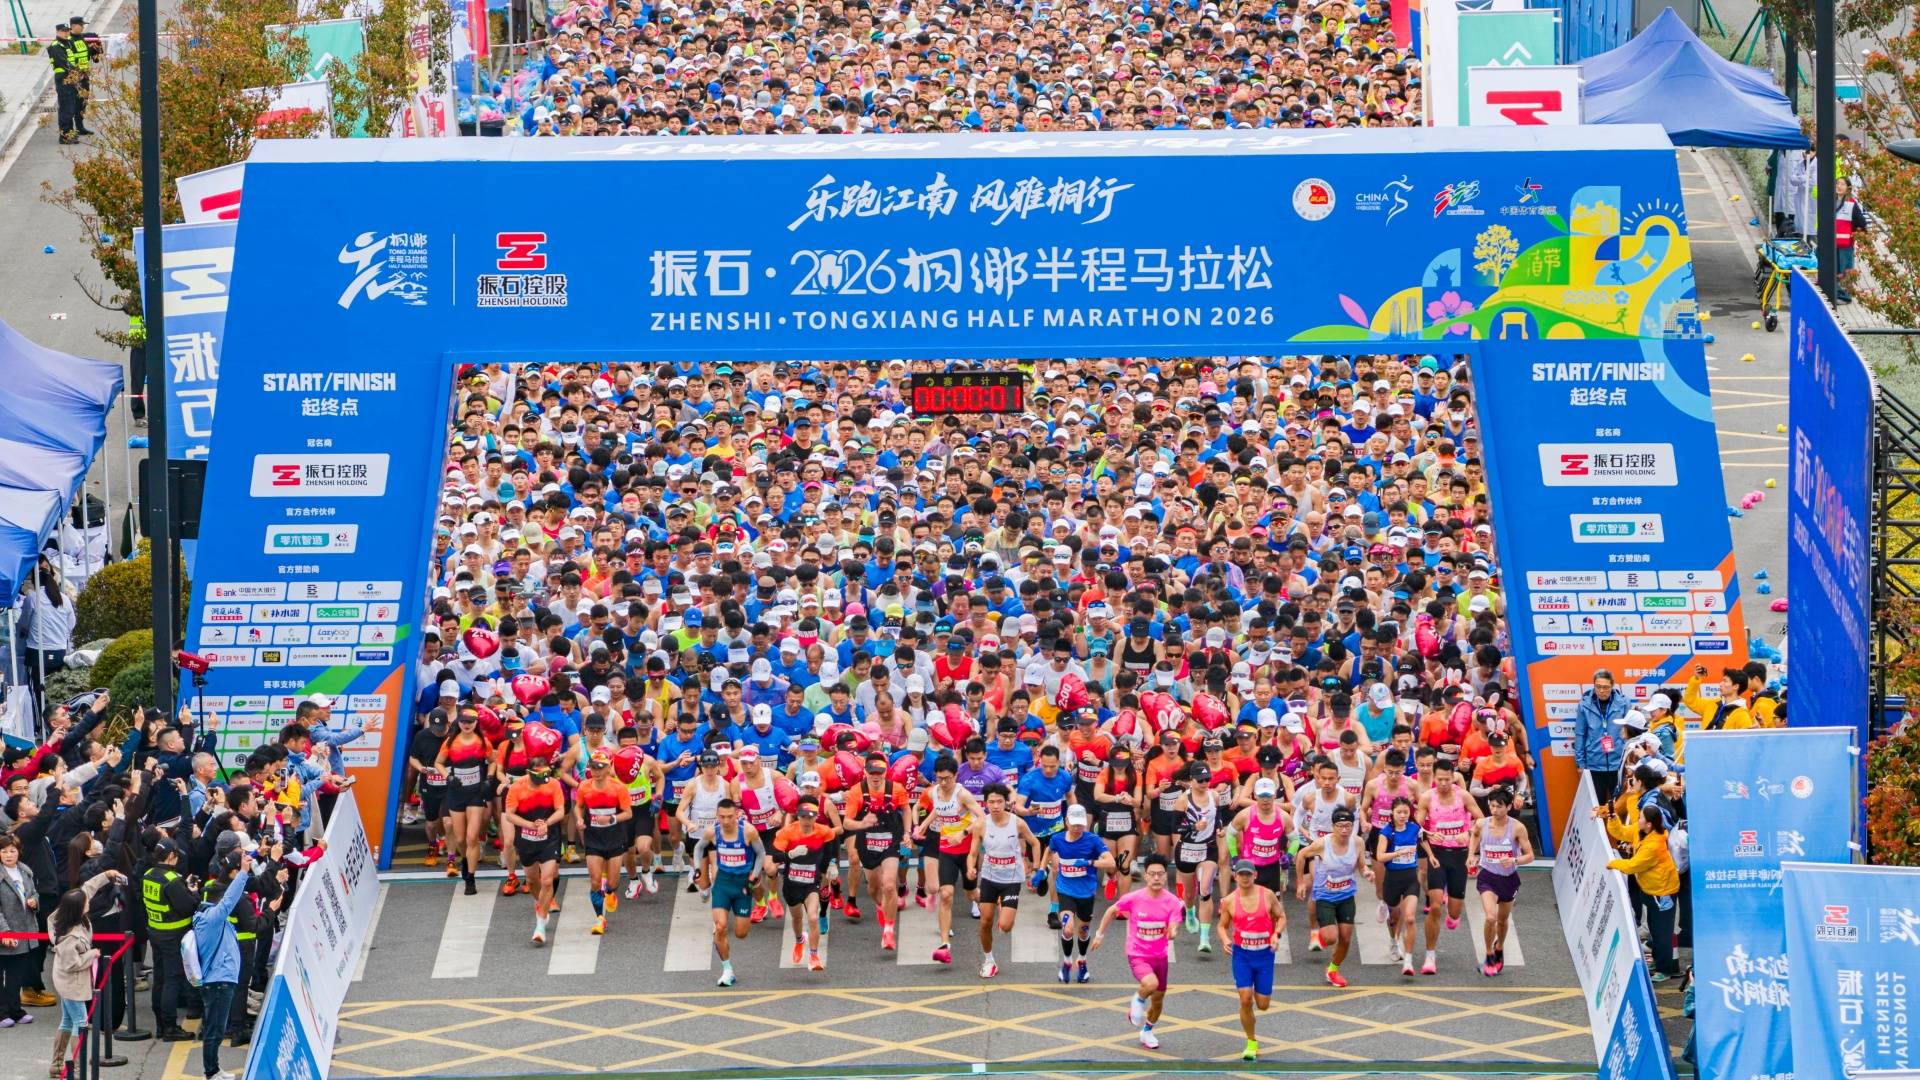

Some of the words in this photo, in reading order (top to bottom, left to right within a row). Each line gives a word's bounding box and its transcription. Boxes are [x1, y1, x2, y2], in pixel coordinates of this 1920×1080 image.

[788, 172, 958, 231] 乐跑江南
[970, 175, 1135, 226] 风雅桐行
[1355, 193, 1389, 201] CHINA
[480, 275, 566, 296] 振石控股
[479, 297, 520, 305] ZHENSHI
[523, 297, 566, 305] HOLDING
[967, 309, 1035, 329] HALF
[1043, 307, 1202, 328] MARATHON
[1211, 306, 1275, 326] 2026
[1532, 362, 1665, 381] START/FINISH
[263, 372, 396, 392] START/FINISH
[914, 385, 1021, 412] 00:00:01
[1570, 387, 1627, 406] 起终点
[301, 397, 359, 417] 起终点
[1595, 428, 1621, 437] 冠名商
[307, 438, 333, 447] 冠名商
[1594, 453, 1656, 468] 振石控股
[305, 464, 368, 479] 振石控股
[1592, 496, 1642, 505] 官方合作伙伴
[286, 507, 336, 516] 官方合作伙伴
[1058, 683, 1072, 710] 2:00
